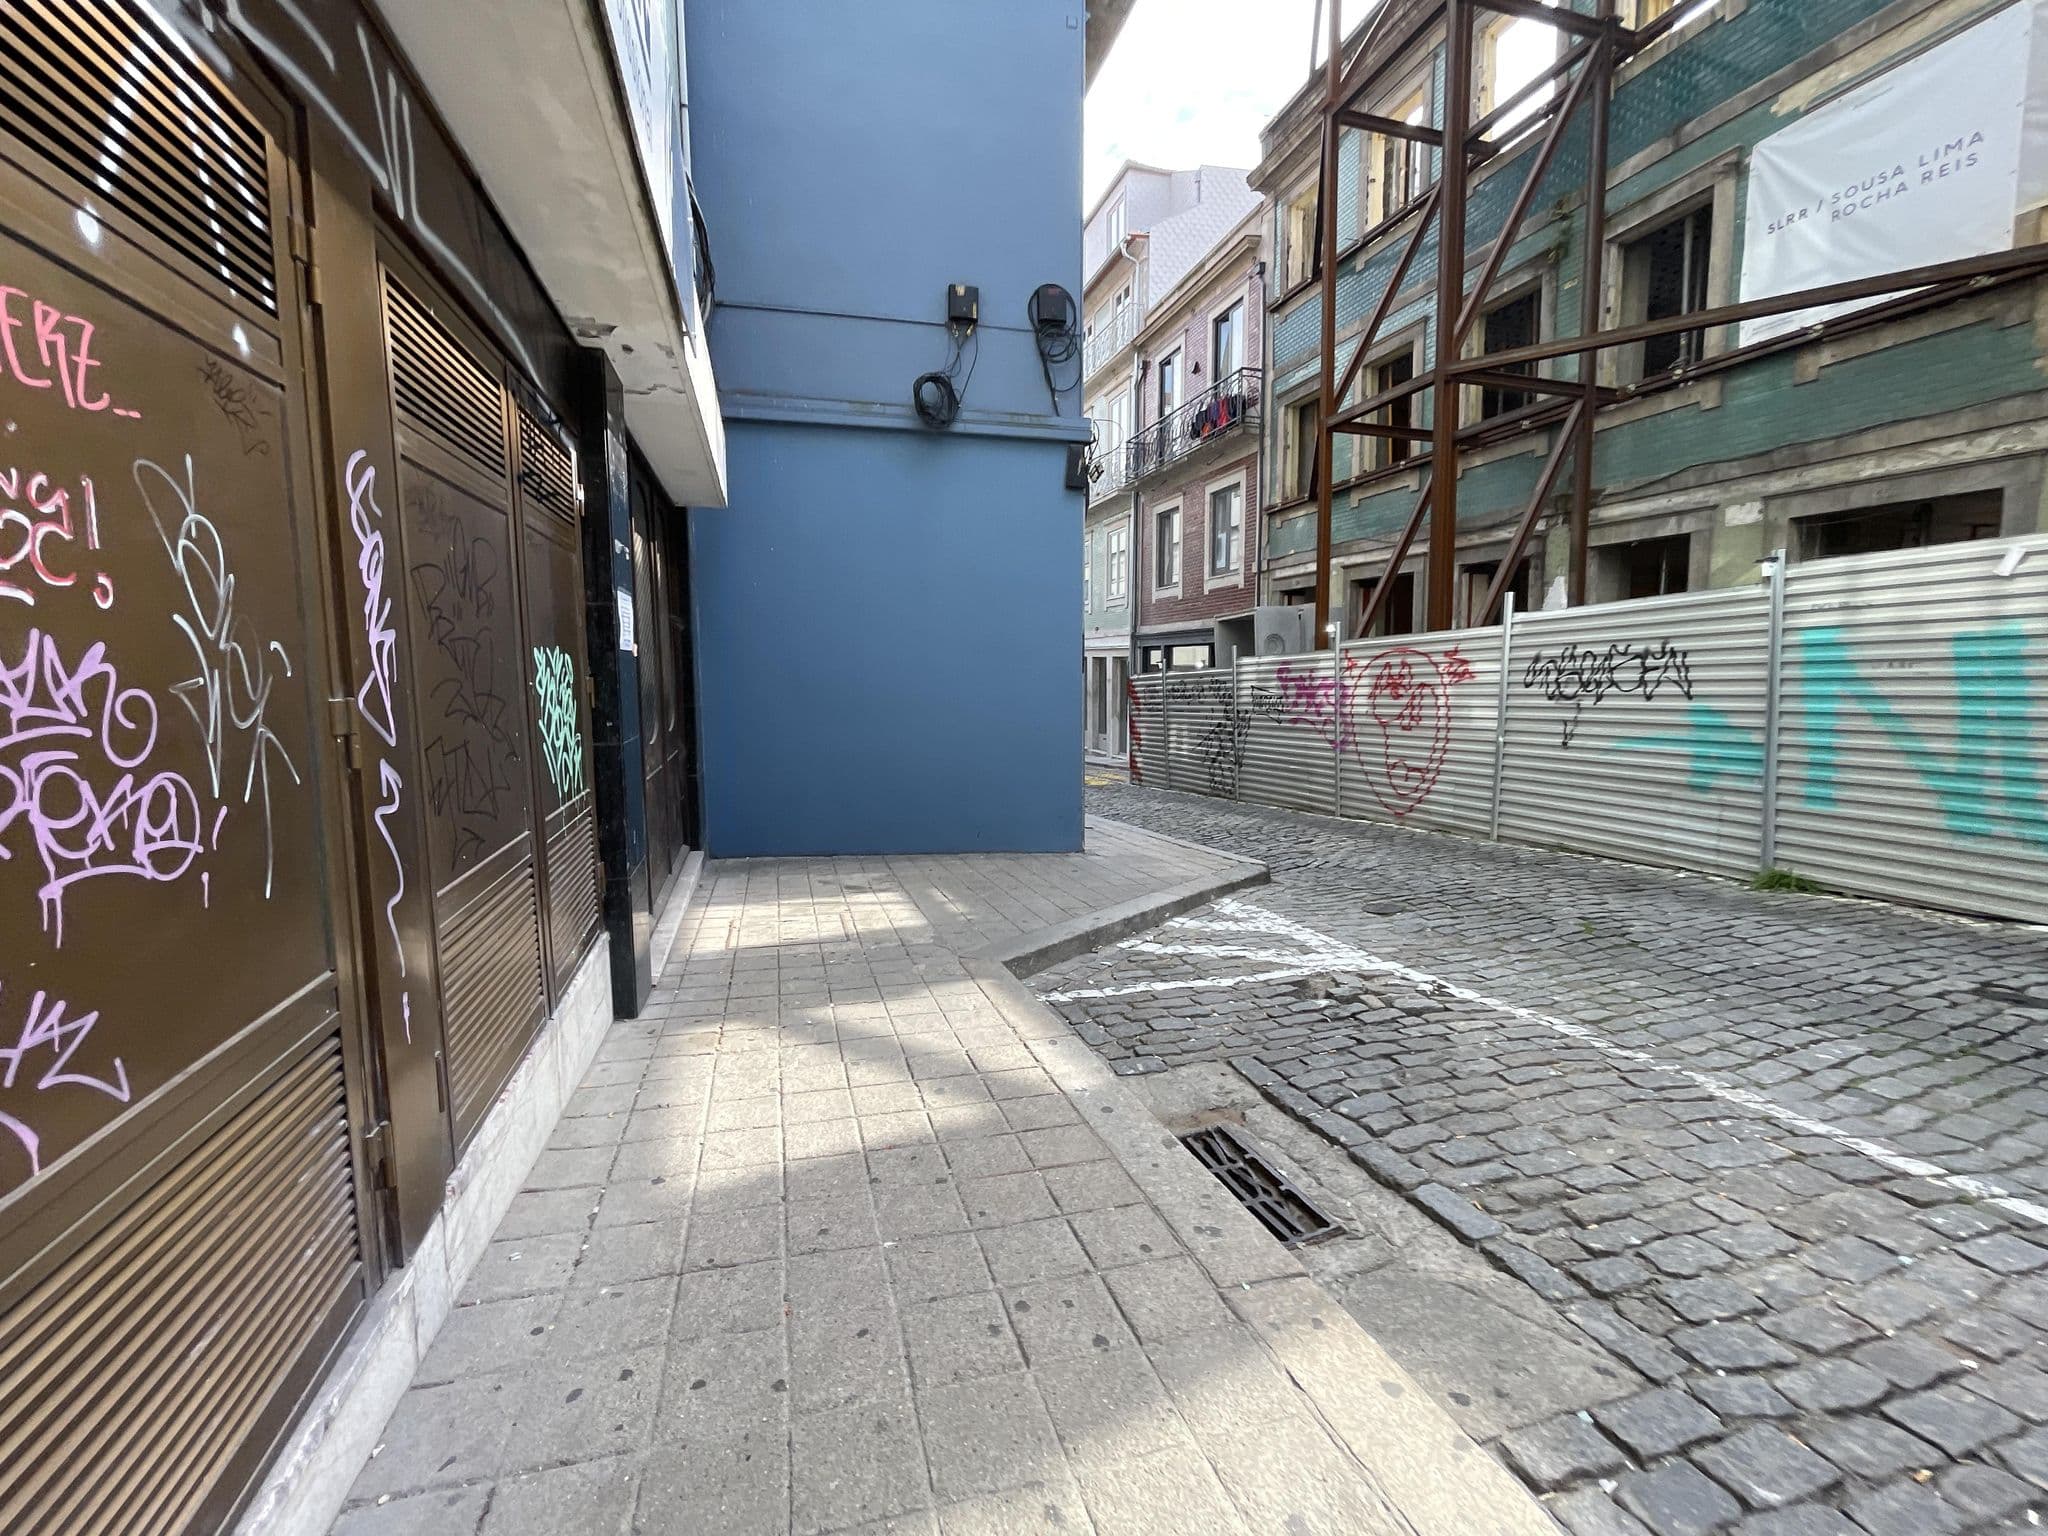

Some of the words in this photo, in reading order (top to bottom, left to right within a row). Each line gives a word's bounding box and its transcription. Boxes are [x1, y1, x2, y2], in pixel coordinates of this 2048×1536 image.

[1767, 208, 1808, 235] SLRR
[1831, 164, 1905, 205] SOUSA
[1918, 131, 1985, 168] LIMA
[1831, 181, 1909, 223] ROCHA
[1920, 152, 1979, 185] REIS
